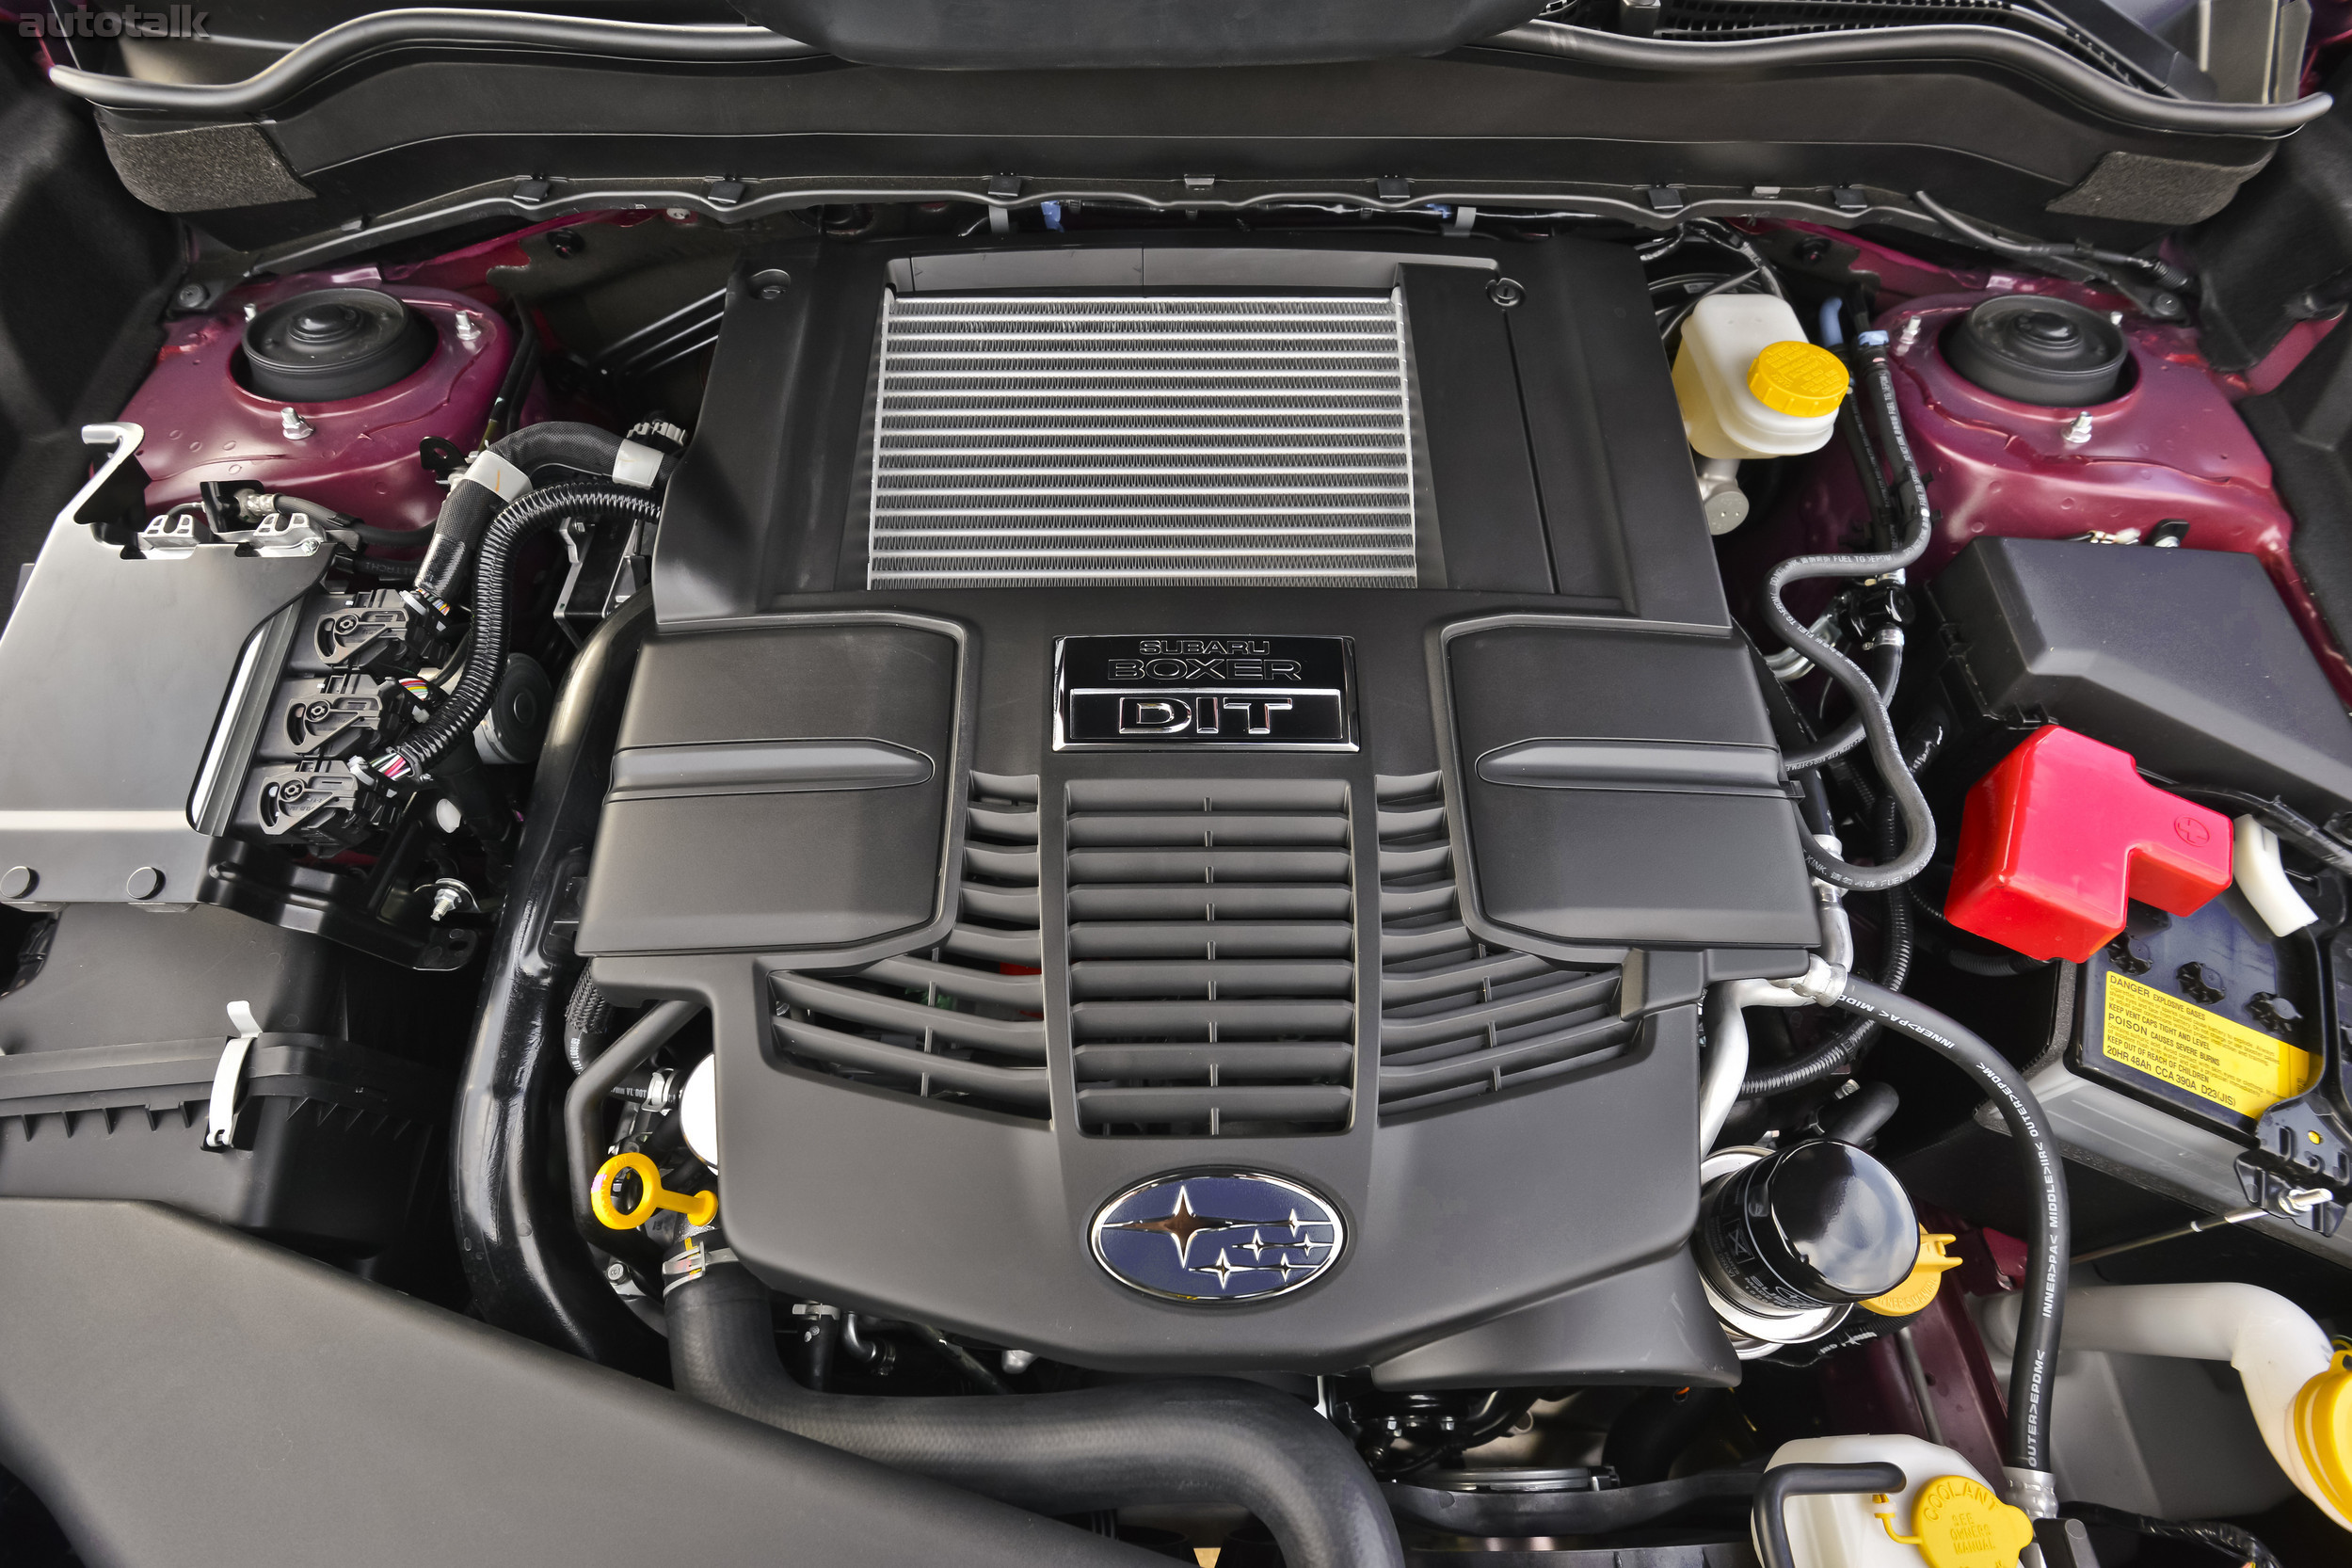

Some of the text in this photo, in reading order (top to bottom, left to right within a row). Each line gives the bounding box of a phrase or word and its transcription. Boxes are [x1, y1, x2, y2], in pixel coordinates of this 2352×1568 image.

[1785, 615, 1796, 626] TG
[1796, 625, 1814, 639] FUEL
[1139, 640, 1270, 655] SUBARU
[1108, 658, 1302, 680] BOXER
[1119, 696, 1292, 734] DIT
[1880, 875, 1905, 888] FUEL
[1907, 867, 1920, 878] TG
[2110, 975, 2205, 1021] DANGER EXPLOSIVE GASES
[2108, 1013, 2219, 1066] POISON CAUSES SEVERE BURNS
[2109, 1002, 2210, 1050] KEEP VENT CAPS TIGHT AND LEVEL
[2107, 1034, 2208, 1083] KEEP OUT OF REACH OF CHILDREN
[2107, 1045, 2235, 1107] 20HR 48Ah CCA 390A D23(JIS)
[1976, 1062, 2058, 1318] INNER>PA< MIDDLE>IIR< OUTER>EPDM<
[2027, 1350, 2045, 1467] OUTER>EPDM<
[1923, 1481, 1999, 1521] COOLANT
[1951, 1512, 1975, 1527] SEE
[1949, 1523, 1992, 1542] OWNERS
[1953, 1538, 1996, 1556] MANUAL
